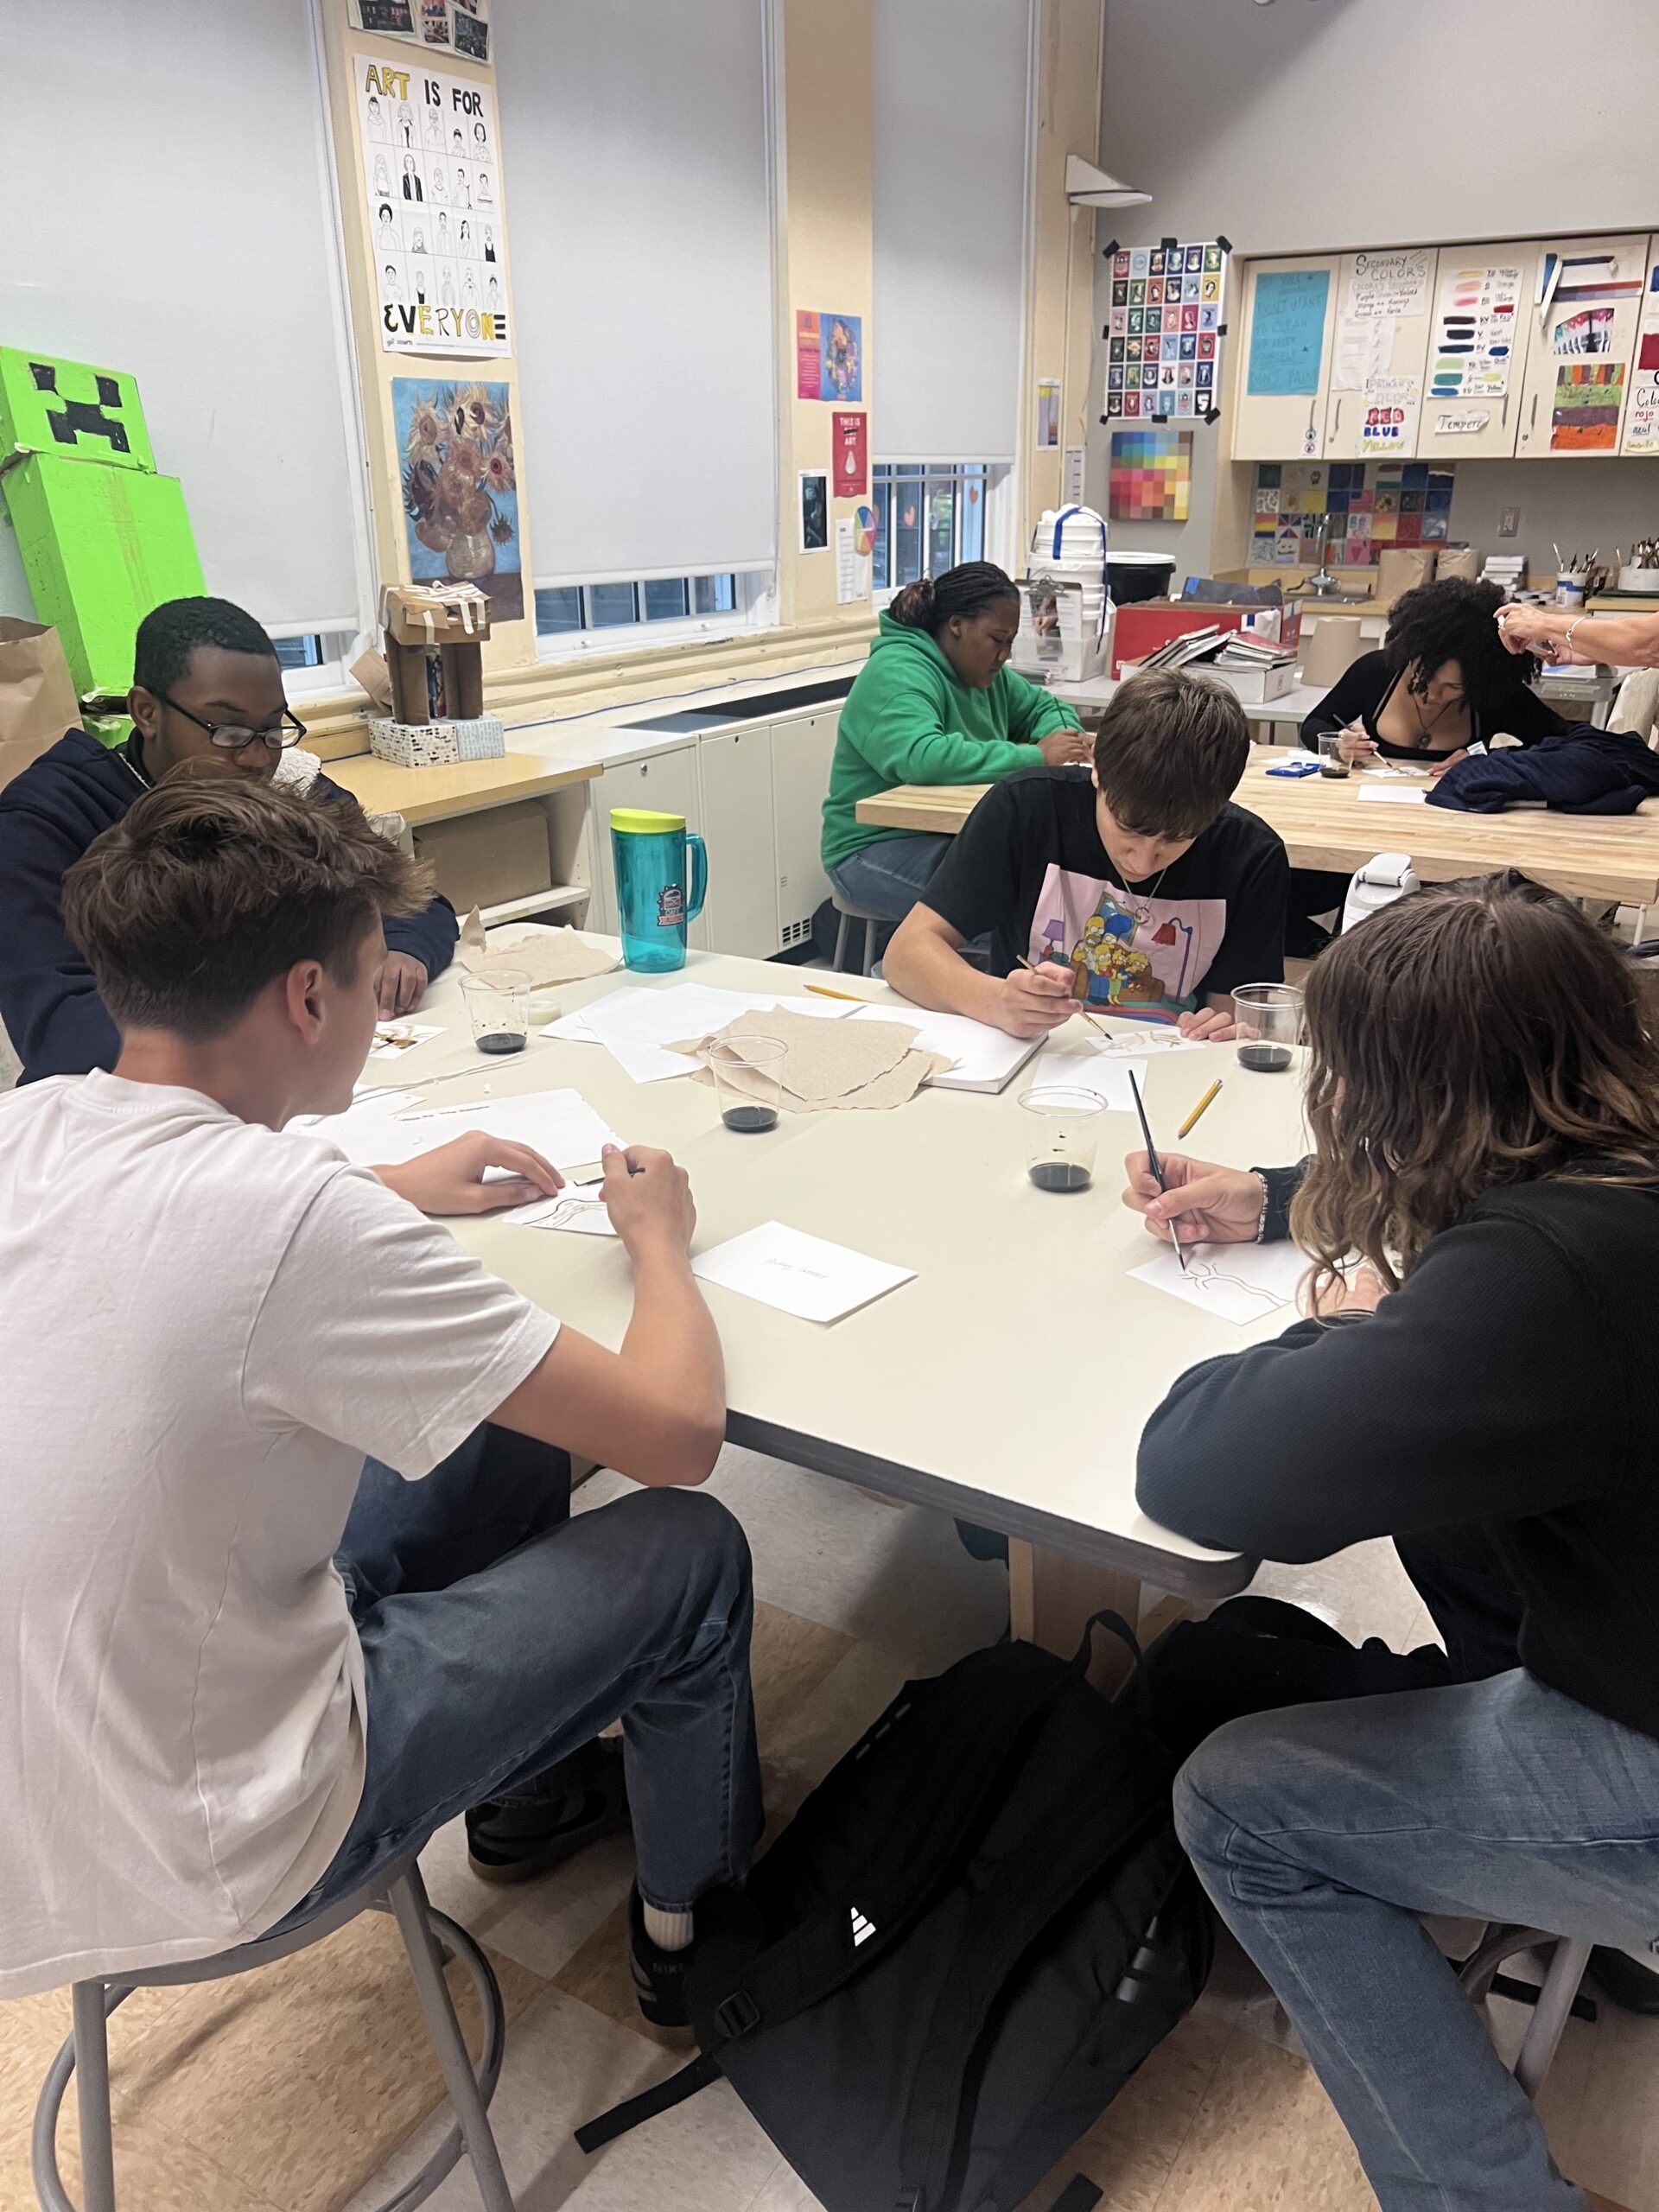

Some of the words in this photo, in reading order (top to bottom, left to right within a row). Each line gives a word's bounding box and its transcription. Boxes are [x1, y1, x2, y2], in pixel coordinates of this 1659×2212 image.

[365, 65, 410, 100] ART
[424, 79, 441, 106] IS
[452, 87, 484, 118] FOR
[1371, 265, 1426, 281] COLORS
[384, 303, 506, 340] EVERYONE
[839, 416, 854, 426] THIS
[854, 416, 861, 426] IS
[1365, 406, 1405, 426] RED
[1635, 410, 1654, 422] rojo
[1363, 425, 1399, 437] BLUE
[1632, 423, 1651, 434] azul
[1362, 439, 1405, 453] YELLOW
